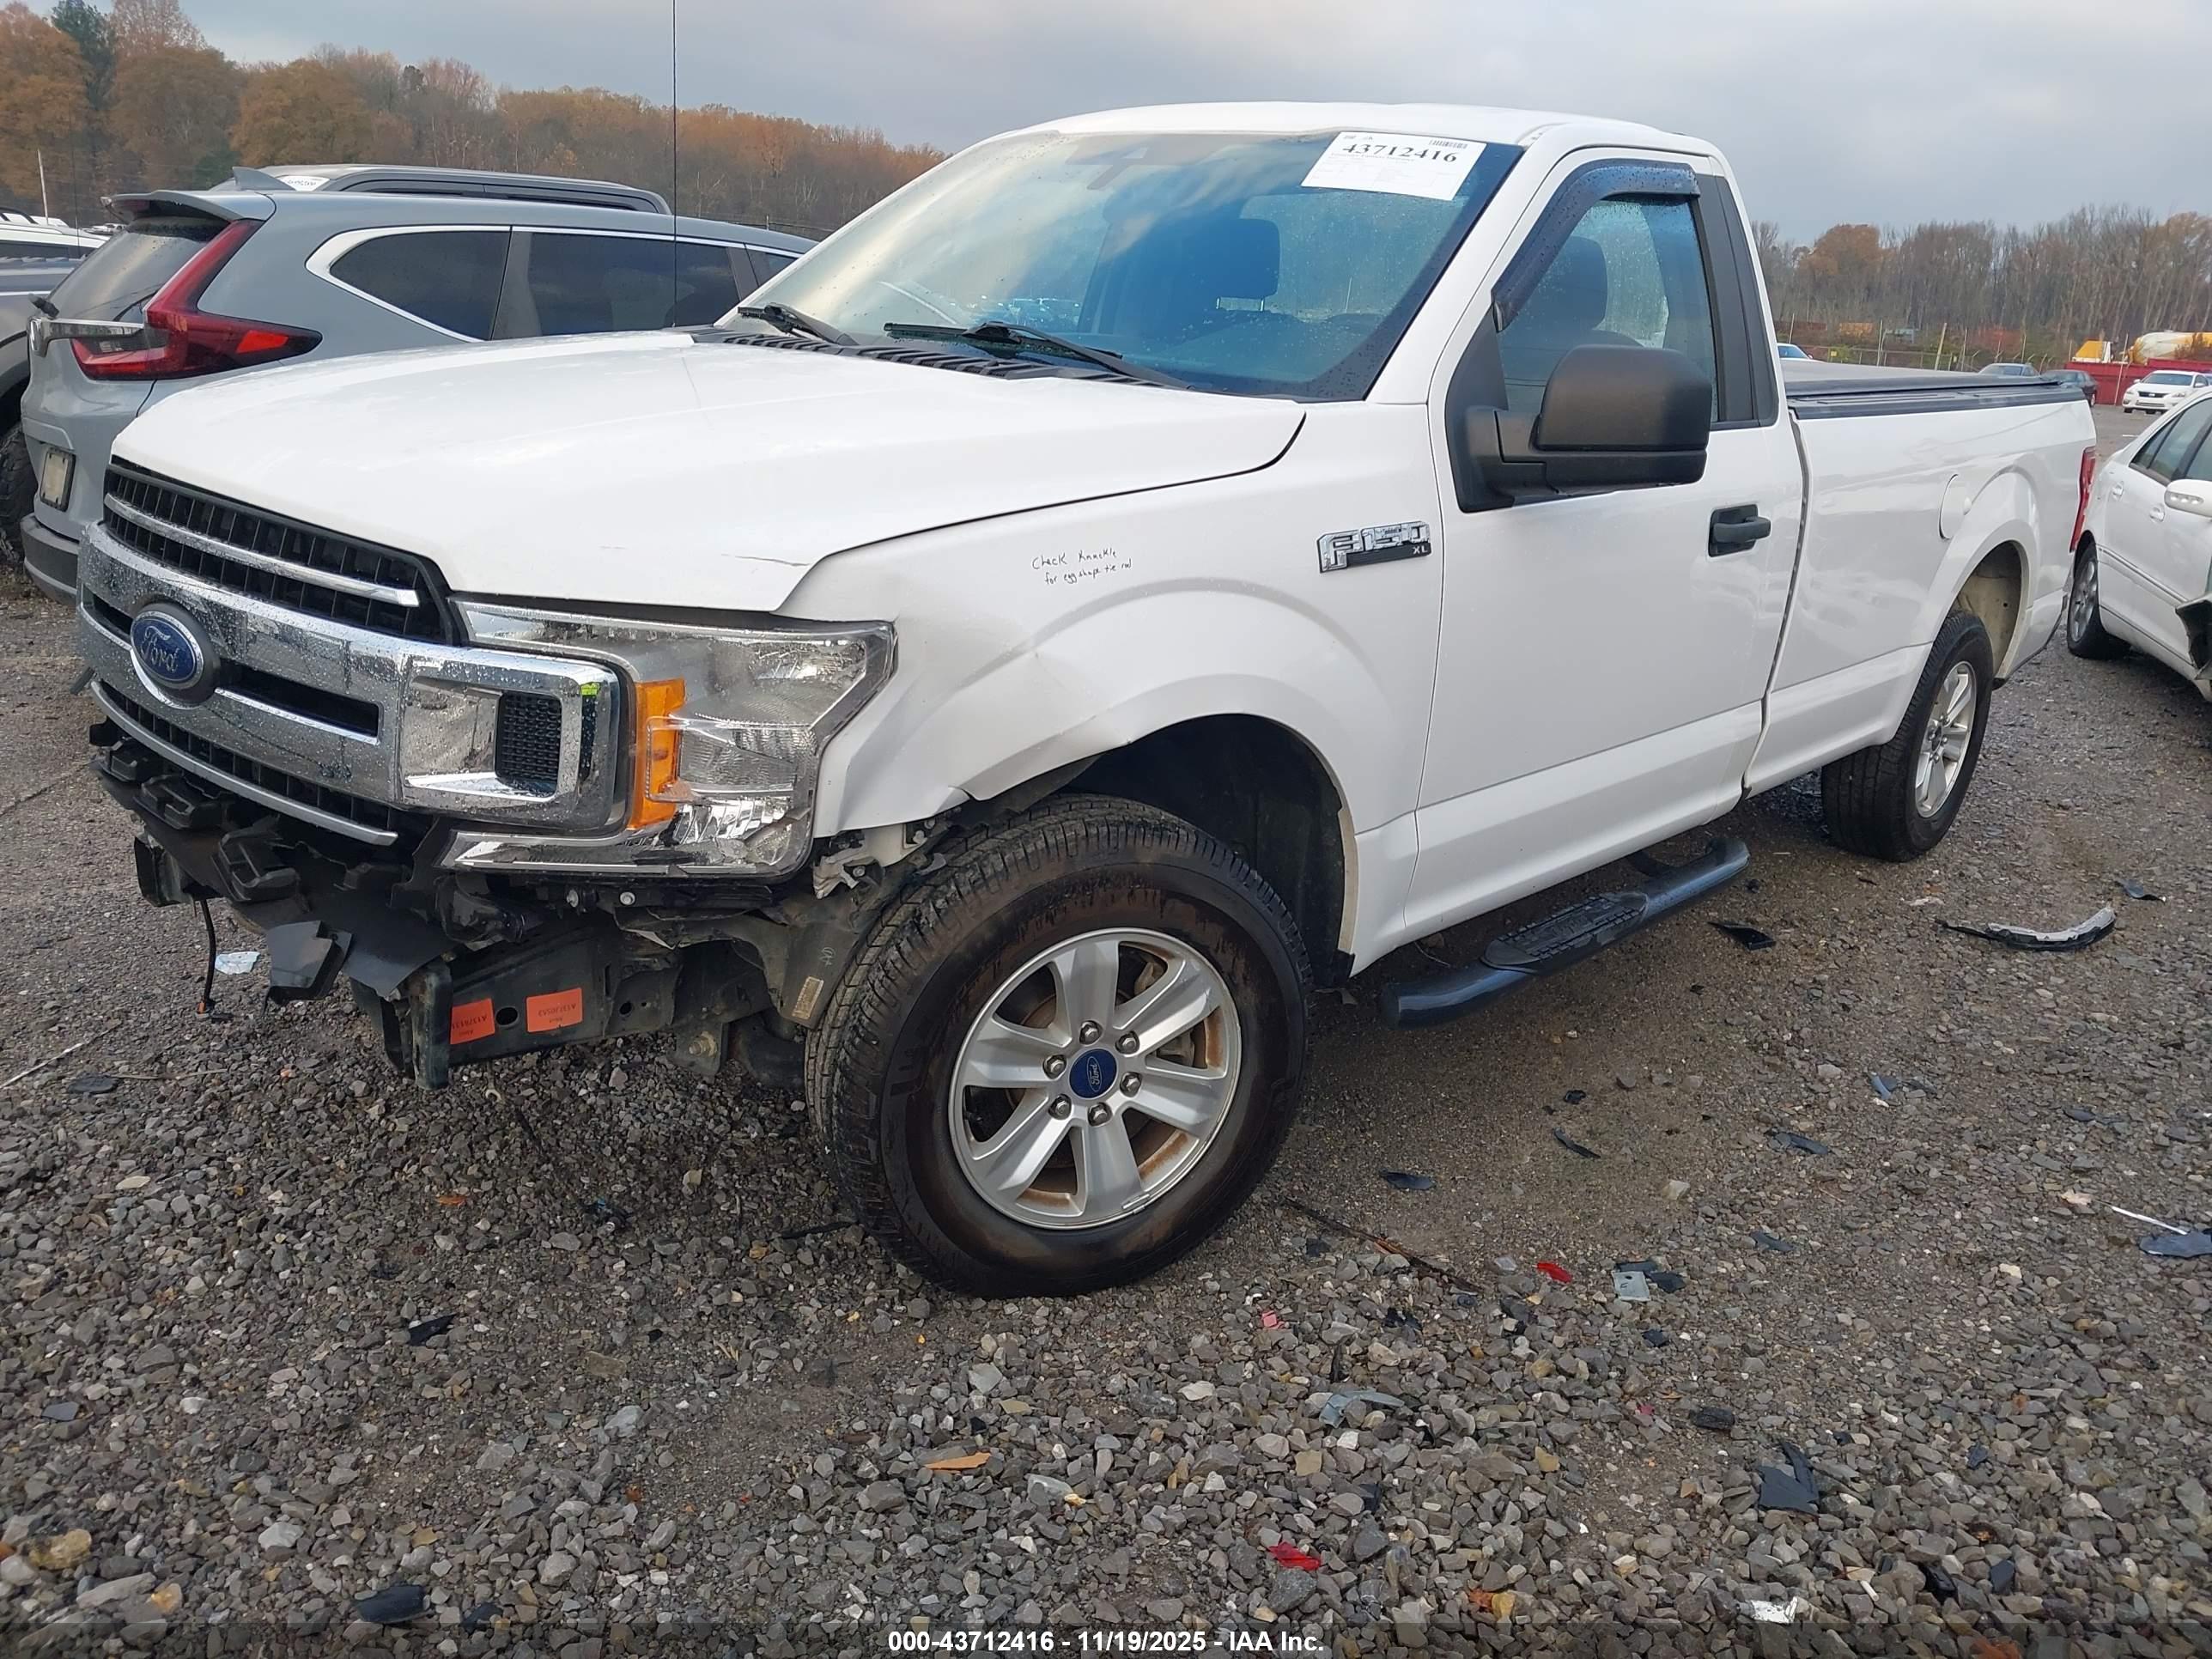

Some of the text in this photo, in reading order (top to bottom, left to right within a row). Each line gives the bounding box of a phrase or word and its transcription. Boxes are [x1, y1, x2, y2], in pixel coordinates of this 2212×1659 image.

[1342, 143, 1457, 163] 43712416
[1412, 544, 1429, 555] XL
[1044, 571, 1058, 585] for
[1104, 563, 1116, 574] tie
[1121, 557, 1133, 568] rod
[140, 625, 180, 673] Ford
[1088, 1062, 1101, 1085] Ford
